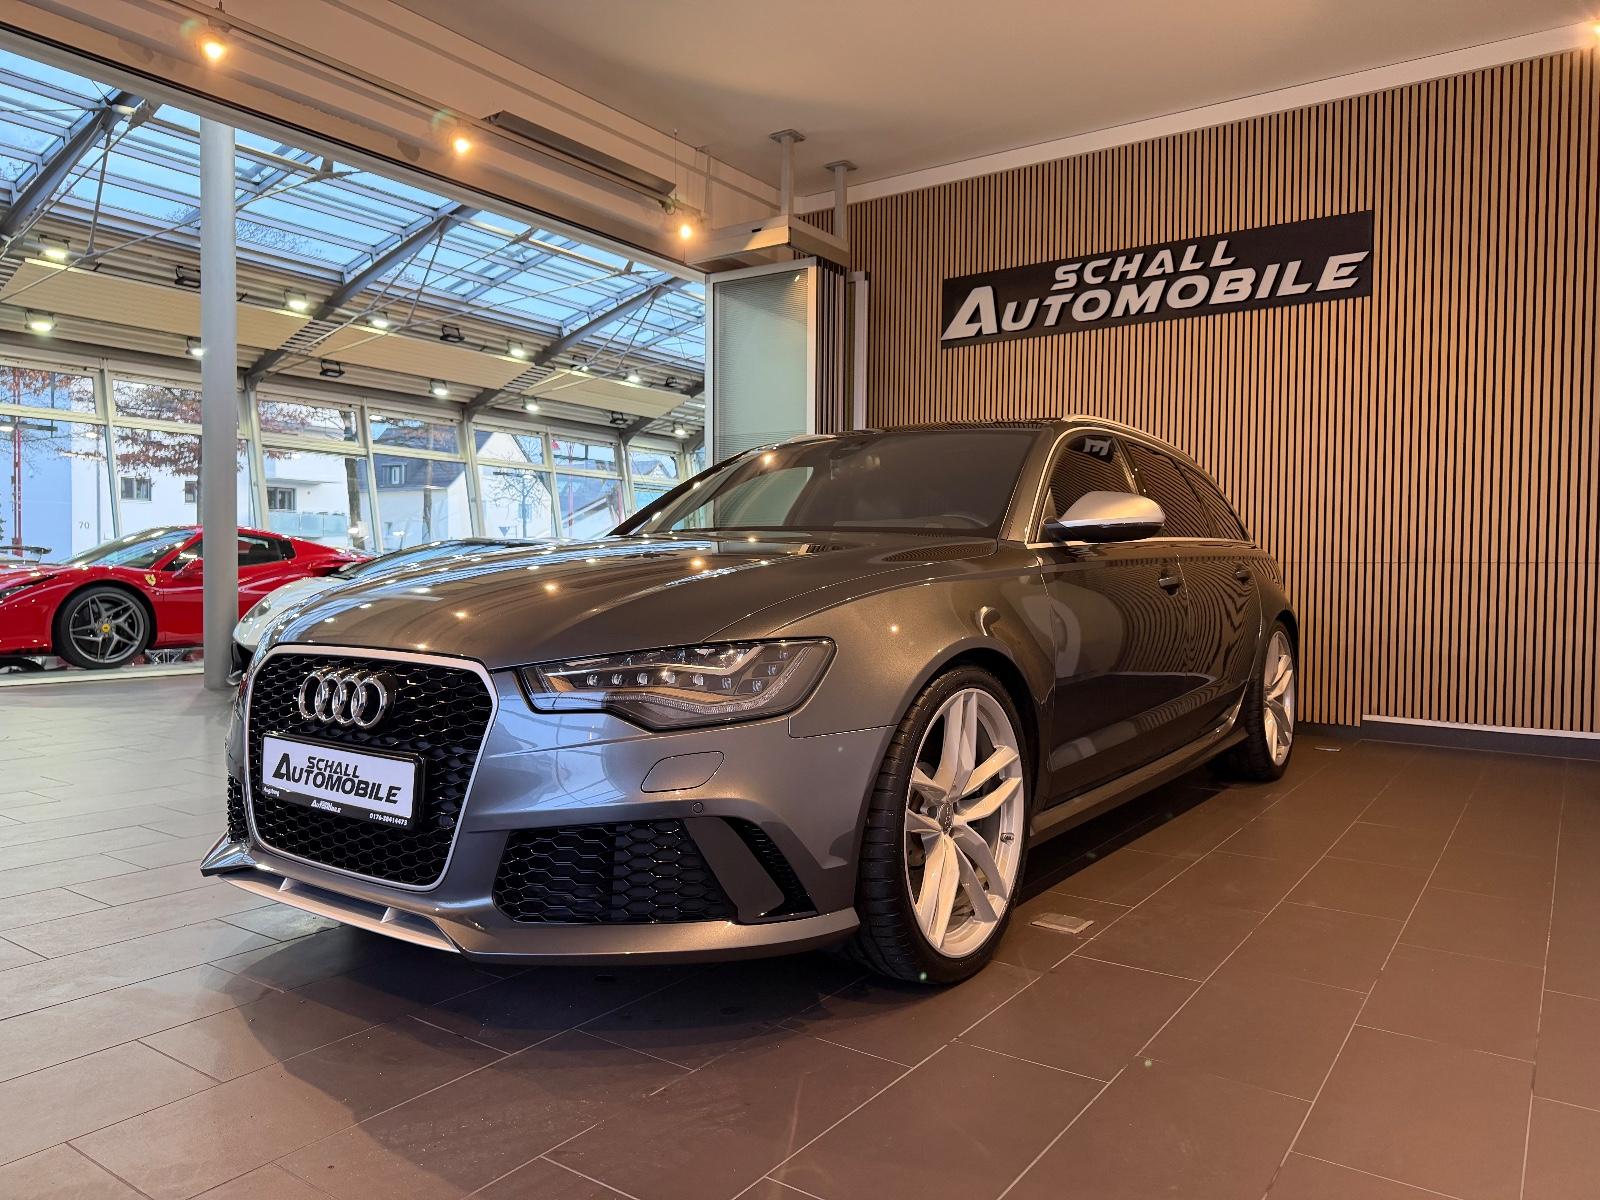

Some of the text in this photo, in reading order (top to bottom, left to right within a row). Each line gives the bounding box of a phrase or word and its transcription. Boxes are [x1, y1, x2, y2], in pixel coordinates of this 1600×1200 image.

[1050, 239, 1237, 291] SCHALL
[941, 251, 1370, 341] AUTOMOBILE
[78, 521, 90, 529] 70
[272, 753, 402, 804] AUTOMOBILE
[306, 755, 360, 778] SCHALL
